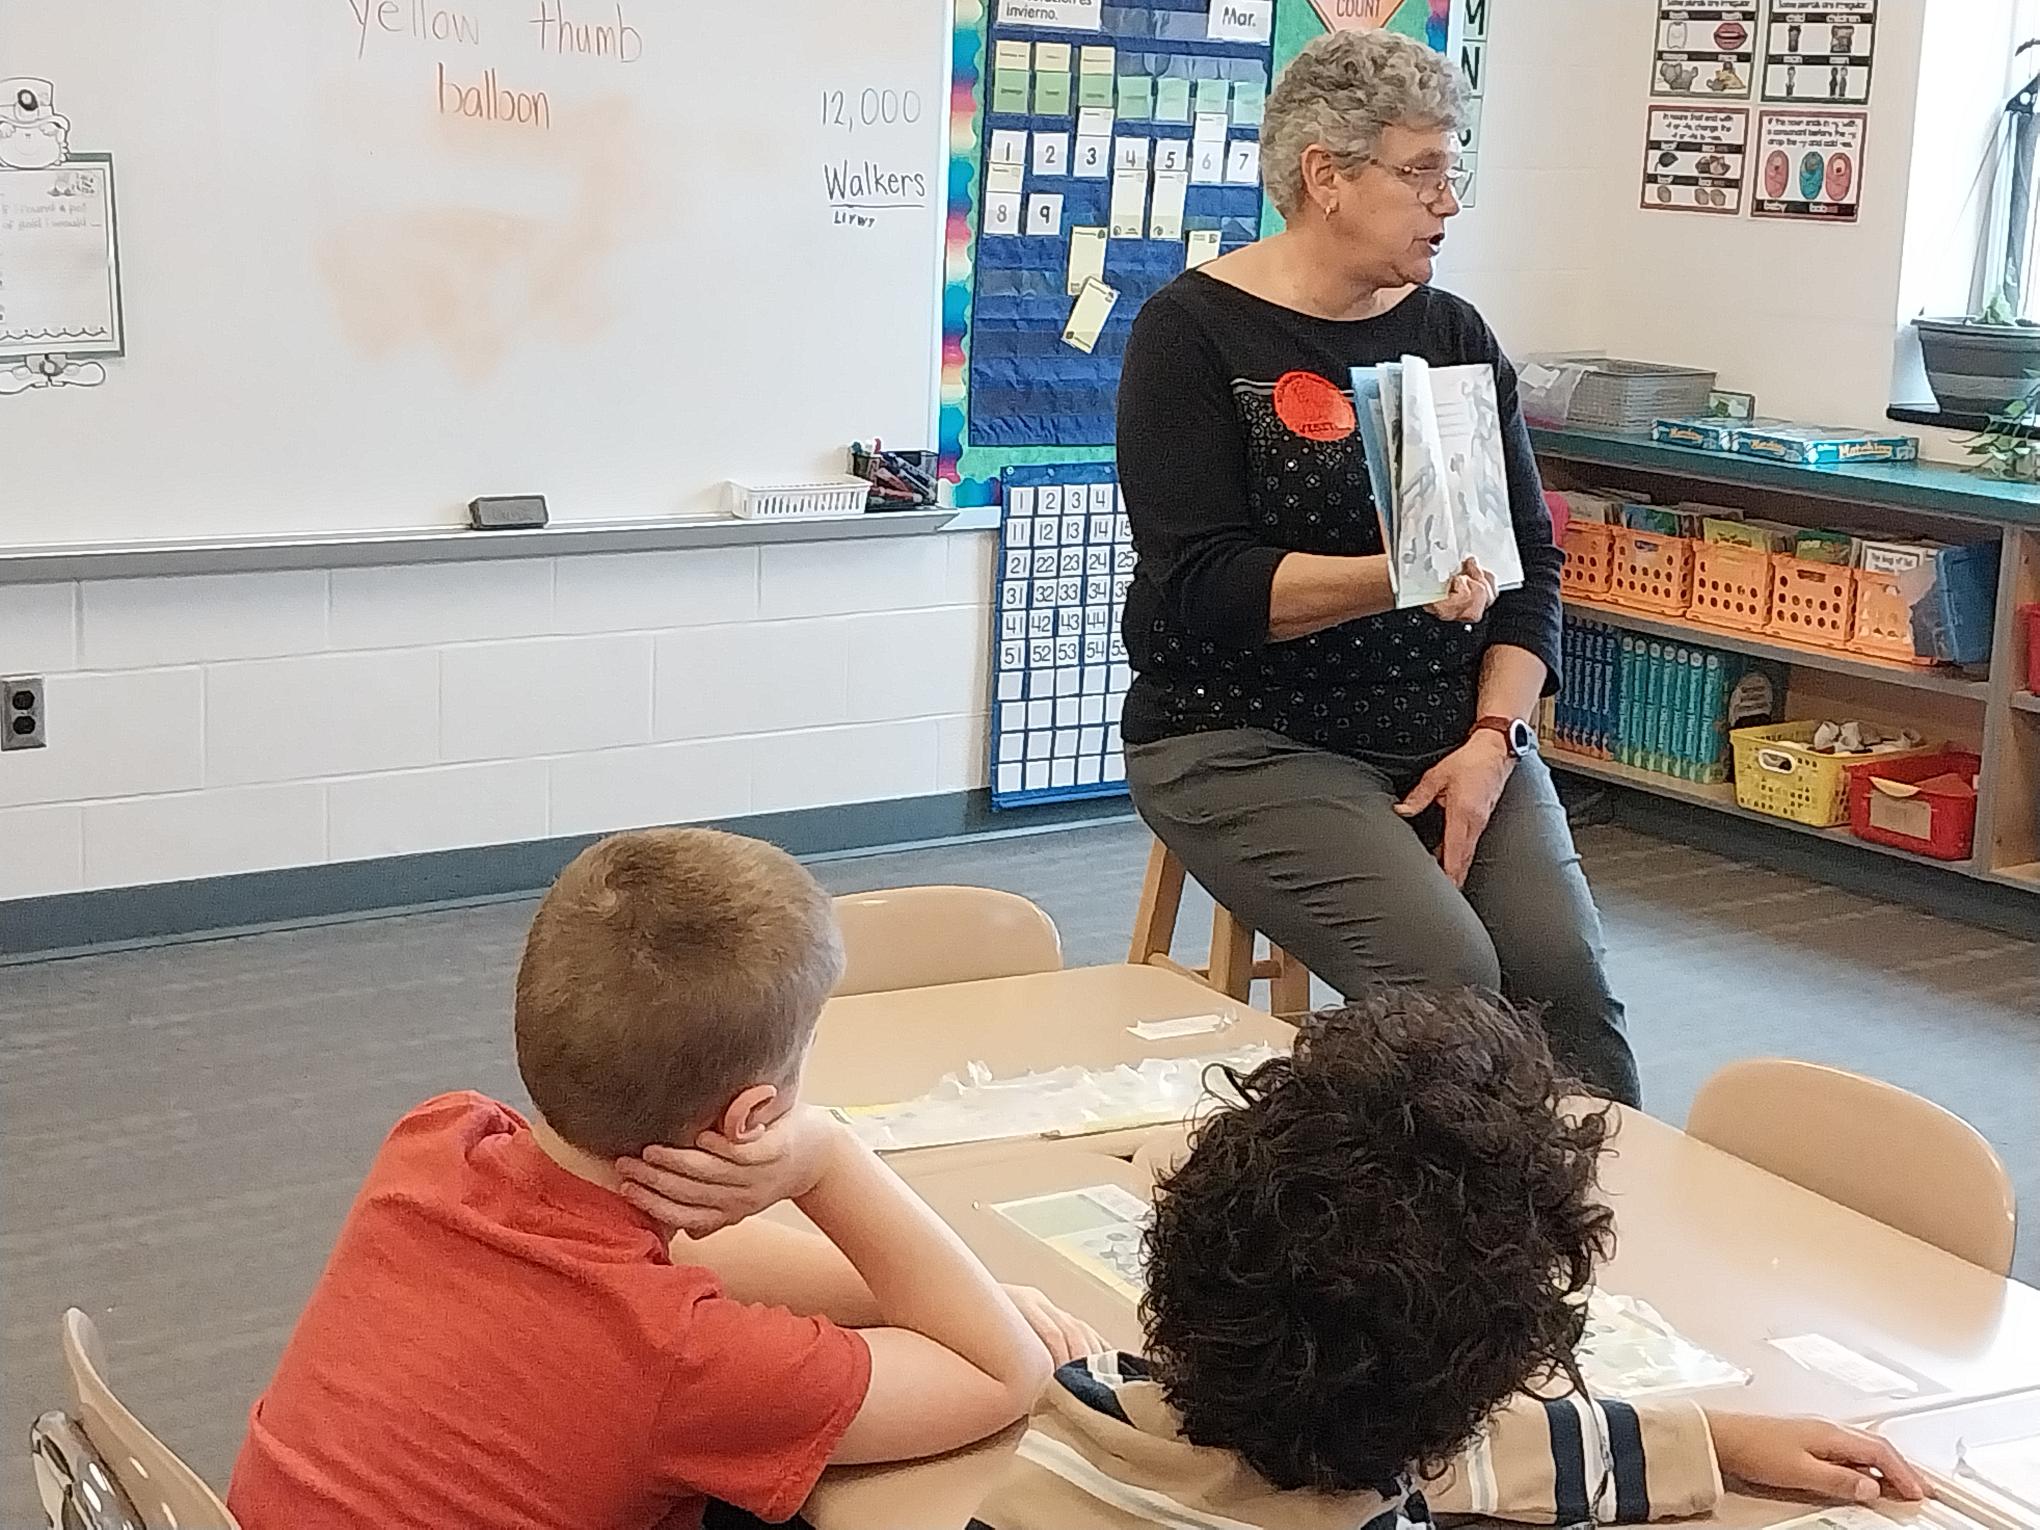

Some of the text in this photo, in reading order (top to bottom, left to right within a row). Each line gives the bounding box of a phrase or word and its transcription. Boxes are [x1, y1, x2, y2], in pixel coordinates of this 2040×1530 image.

[1223, 6, 1256, 27] Mar.
[350, 0, 642, 62] yellow thumb
[1461, 46, 1480, 90] N
[438, 62, 549, 130] balloon
[823, 88, 921, 132] 12,000
[1006, 141, 1249, 170] 1 2 3 4 5 6 7
[824, 159, 925, 200] Walkers
[997, 204, 1051, 224] 8 9
[1045, 492, 1056, 510] 2
[1071, 491, 1081, 509] 3
[1096, 490, 1105, 507] 4
[1013, 523, 1024, 541] 11
[1040, 523, 1053, 541] 12
[1066, 522, 1080, 539] 13
[1094, 520, 1108, 538] 14
[1010, 550, 1135, 574] 21 22 23 24 25
[1006, 587, 1023, 605] 31
[1035, 585, 1054, 603] 32
[1060, 583, 1079, 601] 33
[1088, 581, 1107, 599] 34
[1006, 616, 1023, 634] 41
[1031, 615, 1051, 633] 42
[1061, 613, 1080, 631] 43
[1087, 611, 1106, 629] 44
[1004, 646, 1021, 664] 51
[1032, 645, 1051, 662] 52
[1058, 643, 1077, 660] 53
[1086, 640, 1104, 658] 54
